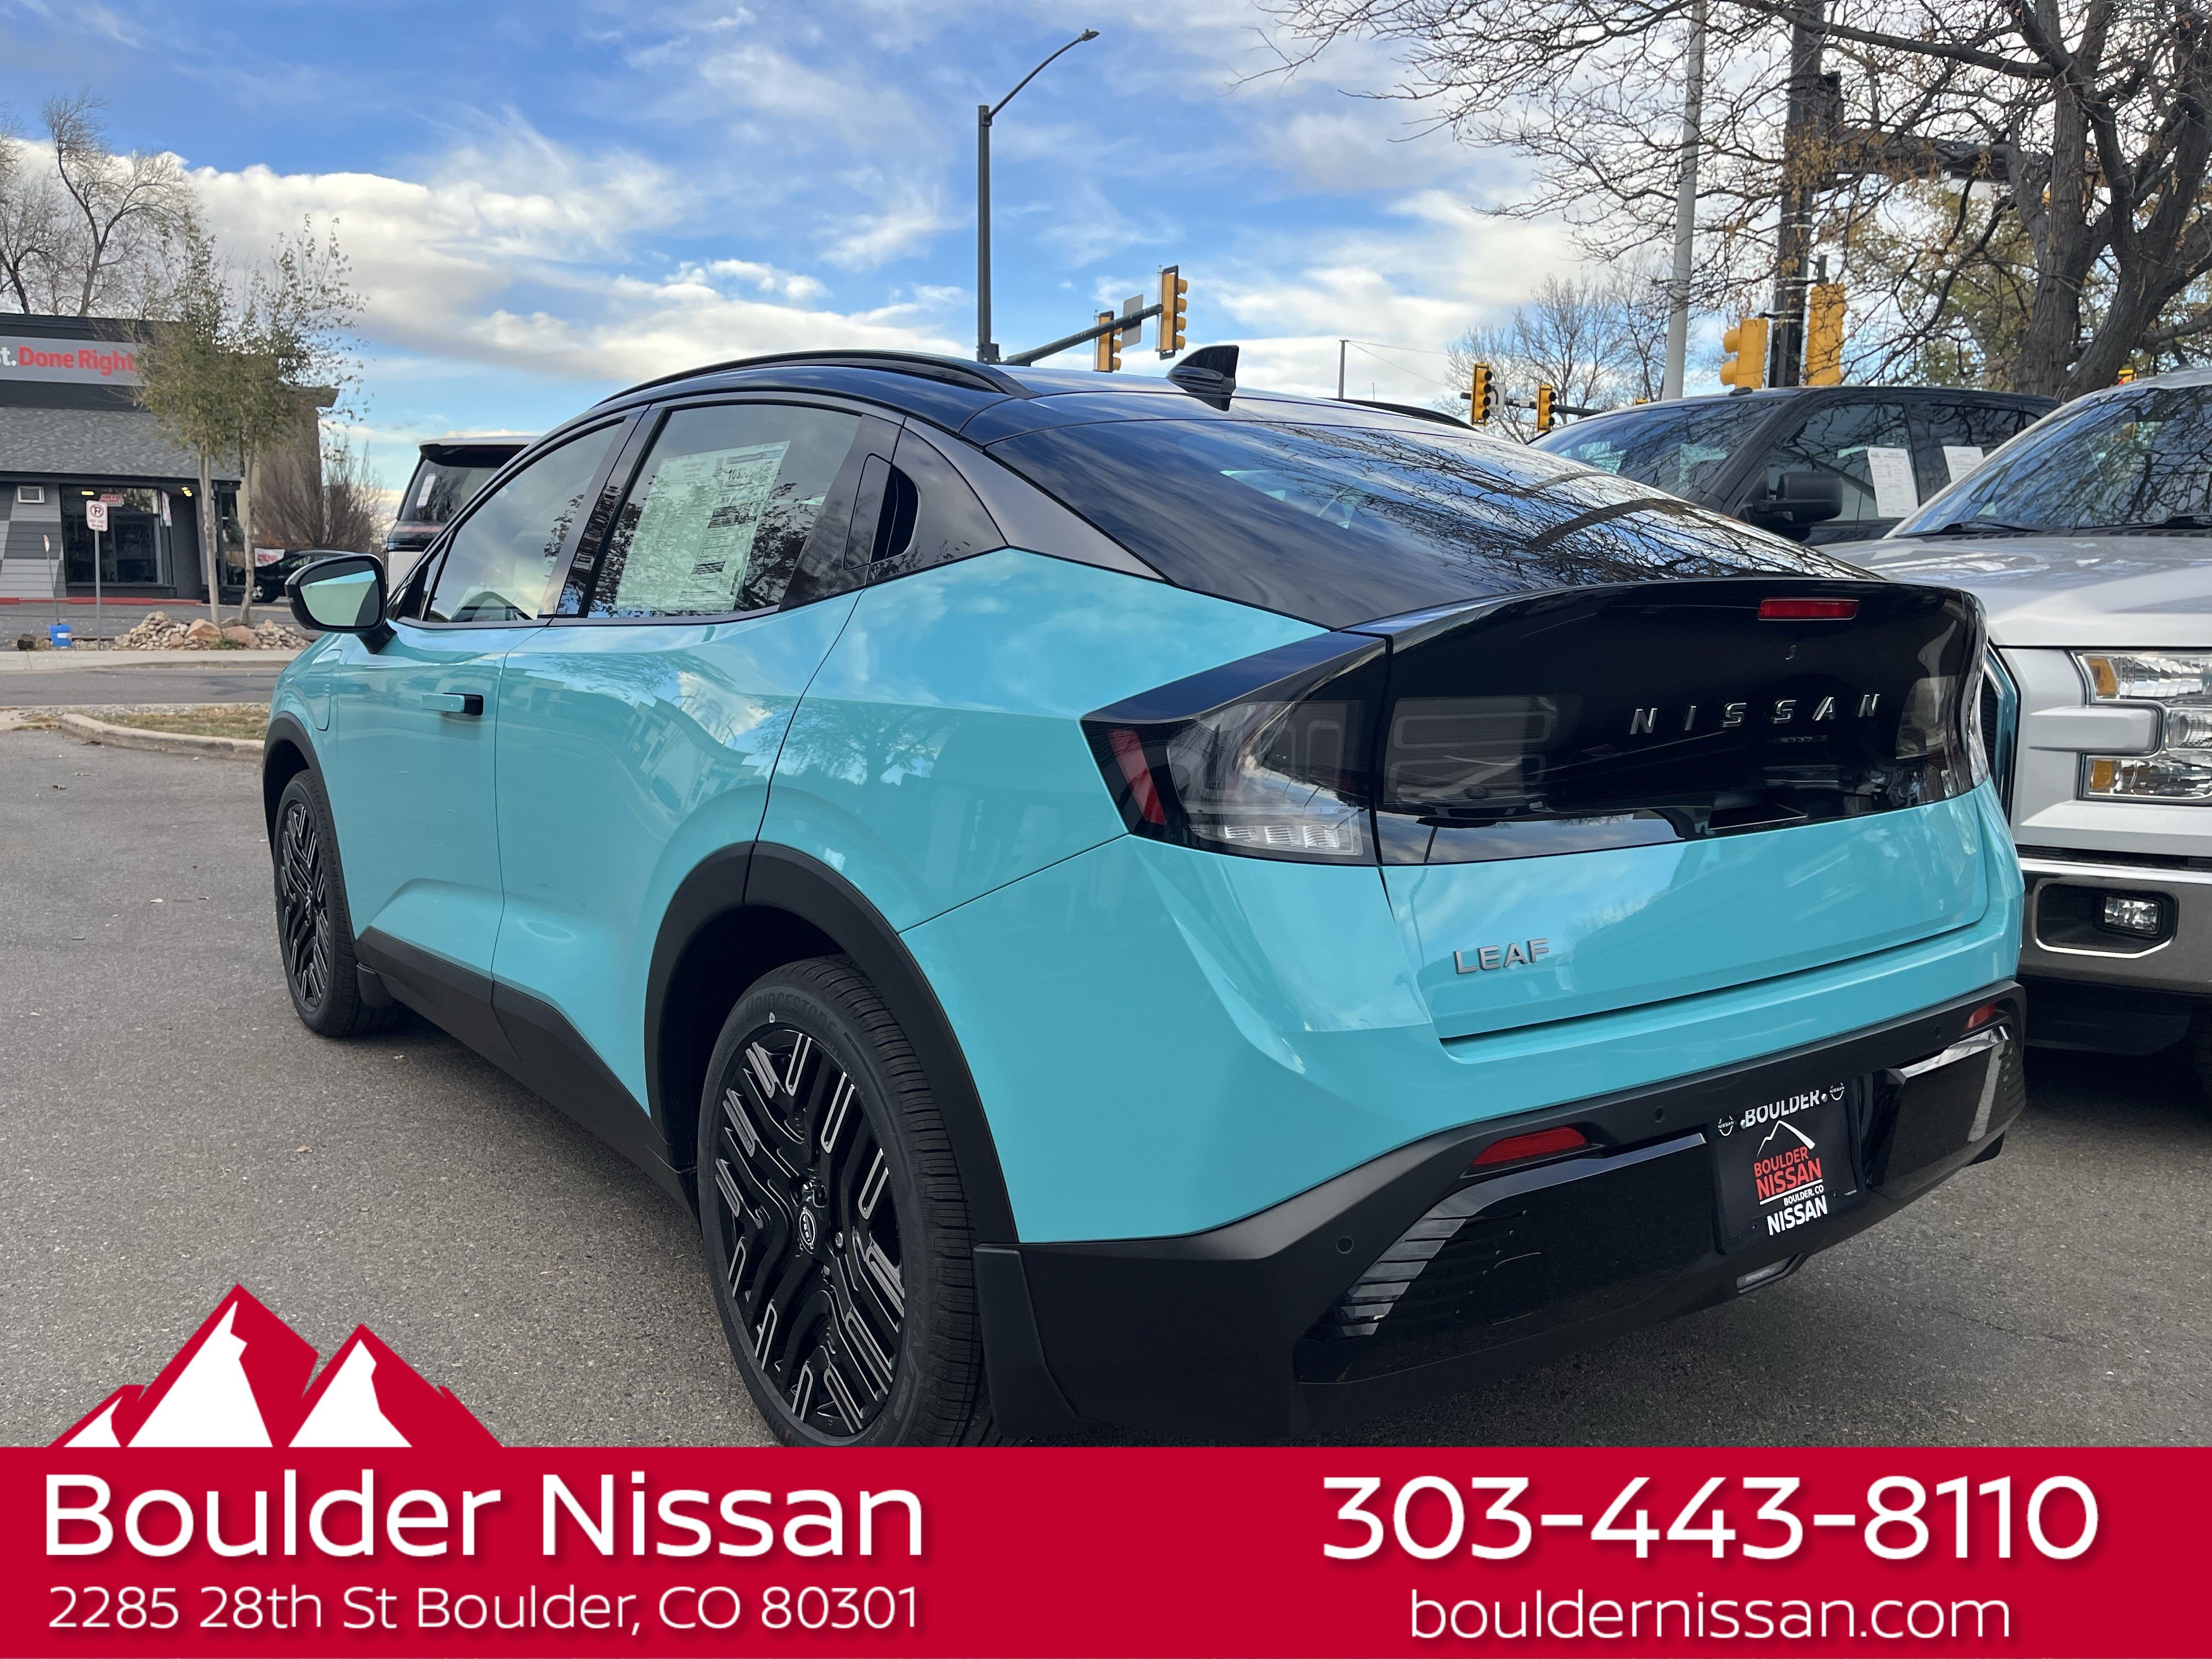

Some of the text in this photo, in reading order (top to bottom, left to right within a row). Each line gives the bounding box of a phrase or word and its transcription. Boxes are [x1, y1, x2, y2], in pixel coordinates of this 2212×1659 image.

[18, 346, 75, 369] Done
[1629, 693, 1880, 735] NISSAN
[1454, 938, 1549, 974] LEAF
[1745, 1089, 1820, 1128] BOULDER
[1753, 1146, 1809, 1177] BOULDER
[1756, 1158, 1822, 1200] NISSAN
[1814, 1184, 1824, 1194] CO
[1767, 1195, 1828, 1236] NISSAN
